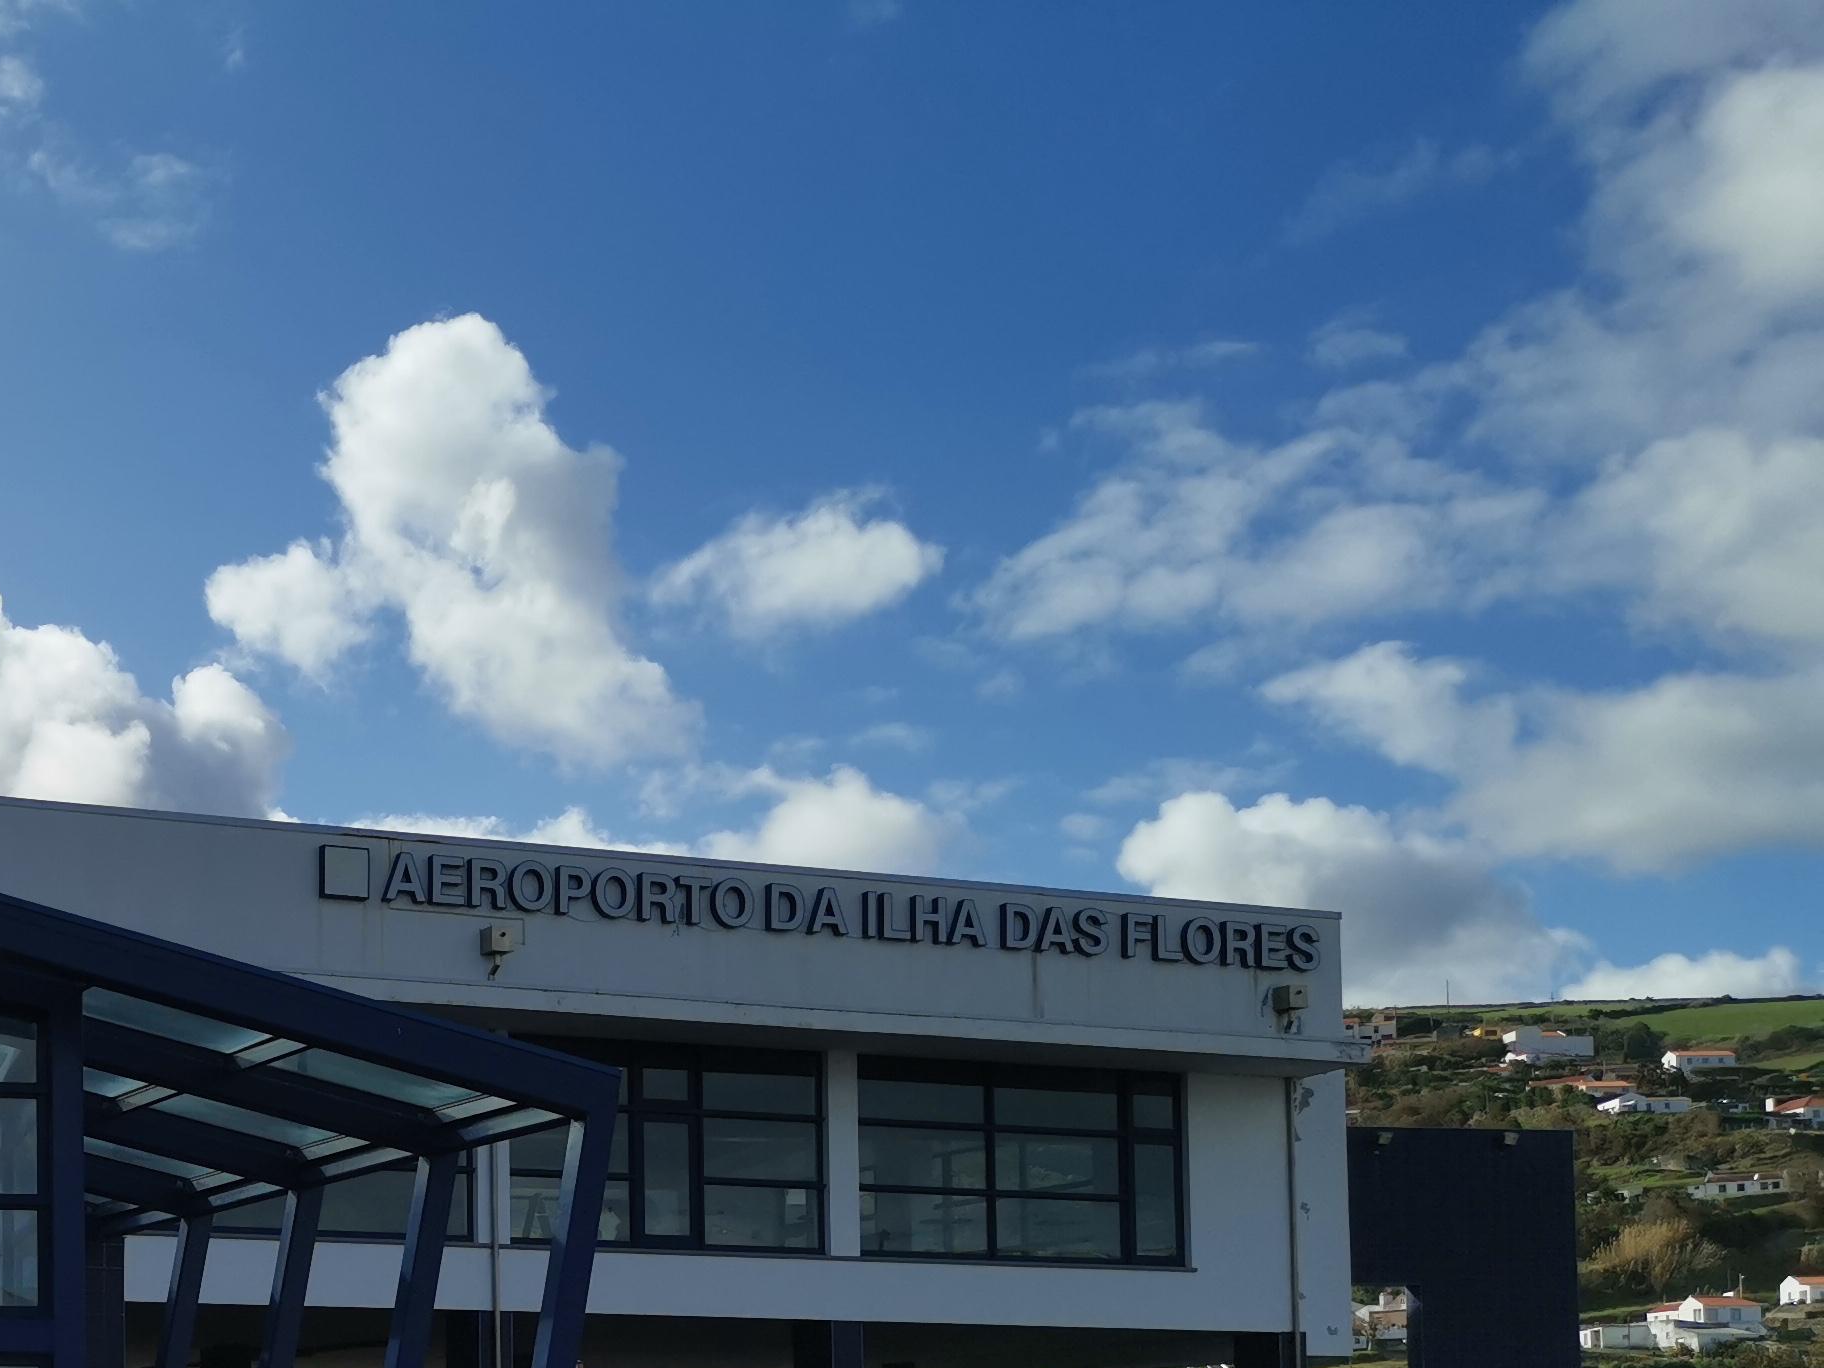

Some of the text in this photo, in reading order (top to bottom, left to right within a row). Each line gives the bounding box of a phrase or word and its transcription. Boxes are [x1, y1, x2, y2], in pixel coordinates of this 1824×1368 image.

[382, 851, 1322, 972] AEROPORTO DA ILHA DAS FLORES
